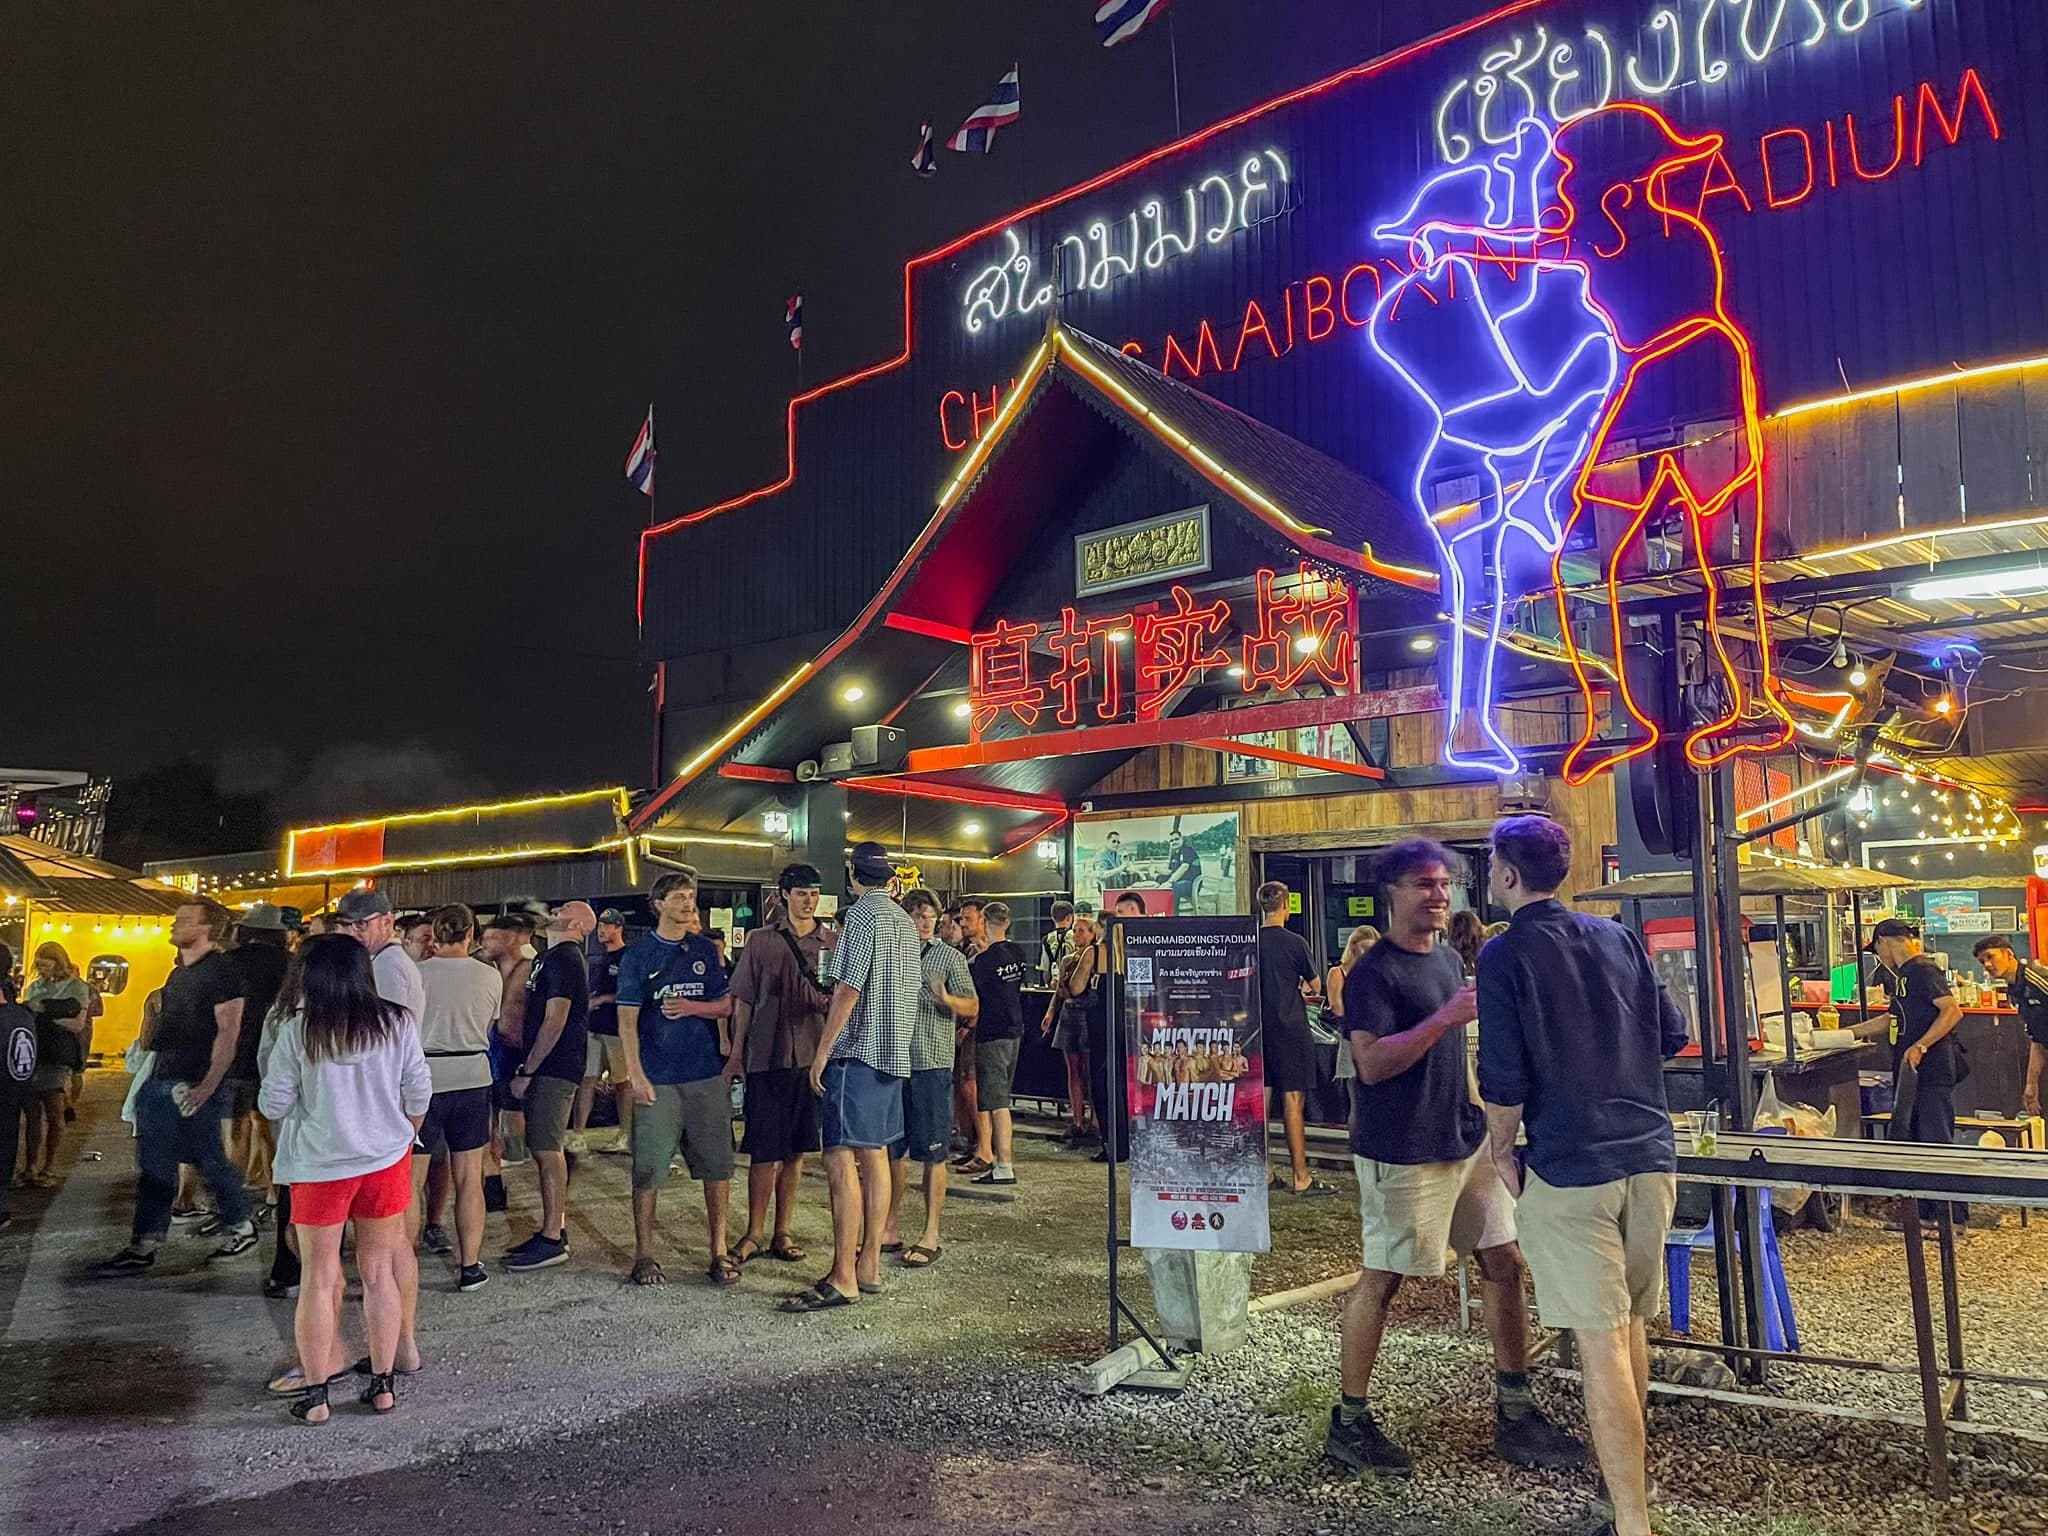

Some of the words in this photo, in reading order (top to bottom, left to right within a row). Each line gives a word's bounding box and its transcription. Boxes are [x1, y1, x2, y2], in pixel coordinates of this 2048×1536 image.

[964, 150, 1290, 335] สนามมวย
[968, 562, 1350, 733] 真打实战
[1126, 935, 1256, 944] CHIANGMAIBOXINGSTADIUM
[1153, 1082, 1235, 1122] MATCH
